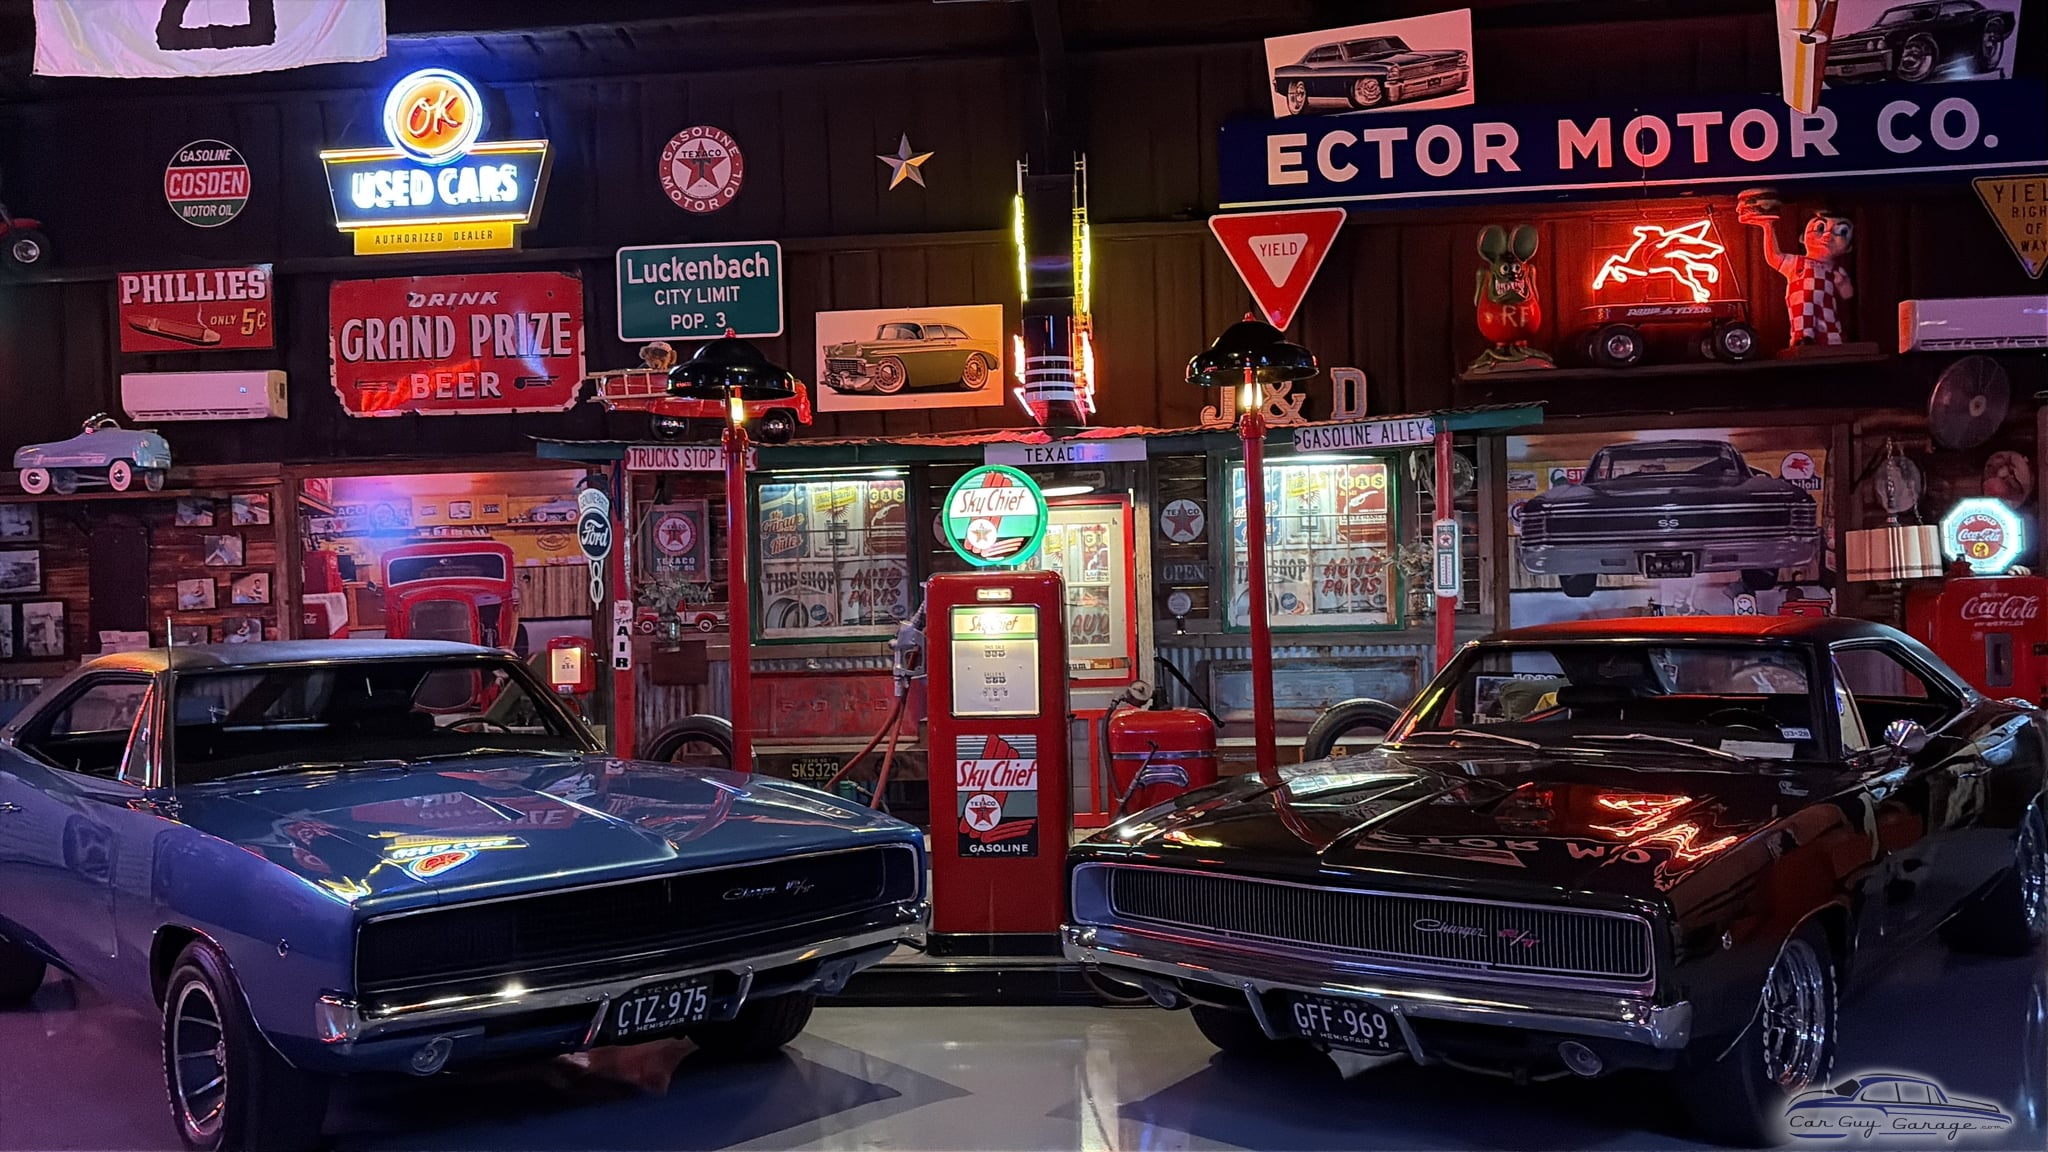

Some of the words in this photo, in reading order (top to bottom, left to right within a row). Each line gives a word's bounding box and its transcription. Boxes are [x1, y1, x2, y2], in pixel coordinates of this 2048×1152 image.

[407, 90, 463, 138] OK
[662, 126, 740, 161] GASOLINE
[1267, 122, 1521, 186] ECTOR
[1557, 106, 1840, 170] MOTOR
[1877, 97, 1999, 153] CO.
[180, 149, 232, 162] GASOLINE
[682, 149, 722, 158] TEXACO
[169, 170, 245, 197] COSDEN
[352, 168, 434, 209] USED
[438, 163, 518, 206] CARS
[662, 175, 720, 211] MOTOR
[724, 170, 743, 198] OIL
[183, 205, 216, 217] MOTOR
[218, 204, 234, 216] OIL
[375, 232, 443, 245] AUTHORIZED
[454, 230, 494, 241] DEALER
[2026, 222, 2043, 235] OF
[1260, 241, 1298, 257] YIELD
[2021, 239, 2048, 251] WAY
[627, 251, 769, 284] Luckenbach
[121, 270, 267, 304] PHILLIES
[654, 288, 692, 306] CITY
[697, 285, 740, 303] LIMIT
[408, 291, 500, 308] DRINK
[210, 314, 237, 325] ONLY
[241, 308, 267, 336] 5¢
[670, 313, 708, 330] POP.
[716, 311, 727, 328] 3
[341, 315, 456, 362] GRAND
[471, 311, 573, 357] PRIZE
[410, 371, 502, 399] BEER
[1330, 366, 1367, 420] D
[1303, 425, 1373, 449] GASOLINE
[1381, 421, 1425, 444] ALLEY
[633, 448, 679, 468] TRUCKS
[684, 447, 716, 468] STOP
[1025, 447, 1084, 463] TEXACO
[1341, 476, 1383, 487] GAS
[870, 490, 904, 500] GAS
[960, 490, 984, 514] Sky
[986, 488, 1025, 511] Chief
[1657, 518, 1680, 527] SS
[1963, 515, 1976, 526] ICE
[1977, 514, 1998, 526] COLD
[581, 518, 609, 547] Ford
[850, 567, 902, 590] AUTO
[1163, 564, 1206, 581] OPEN
[1272, 558, 1307, 582] SHOP
[1323, 556, 1383, 579] AUTO
[766, 571, 797, 596] TIRE
[800, 570, 835, 595] SHOP
[1321, 577, 1382, 598] PARTS
[848, 588, 901, 608] PARTS
[615, 626, 630, 668] AIR
[957, 761, 990, 791] Sky
[991, 760, 1038, 787] Chief
[969, 844, 1029, 853] GASOLINE
[1413, 918, 1488, 939] Charger
